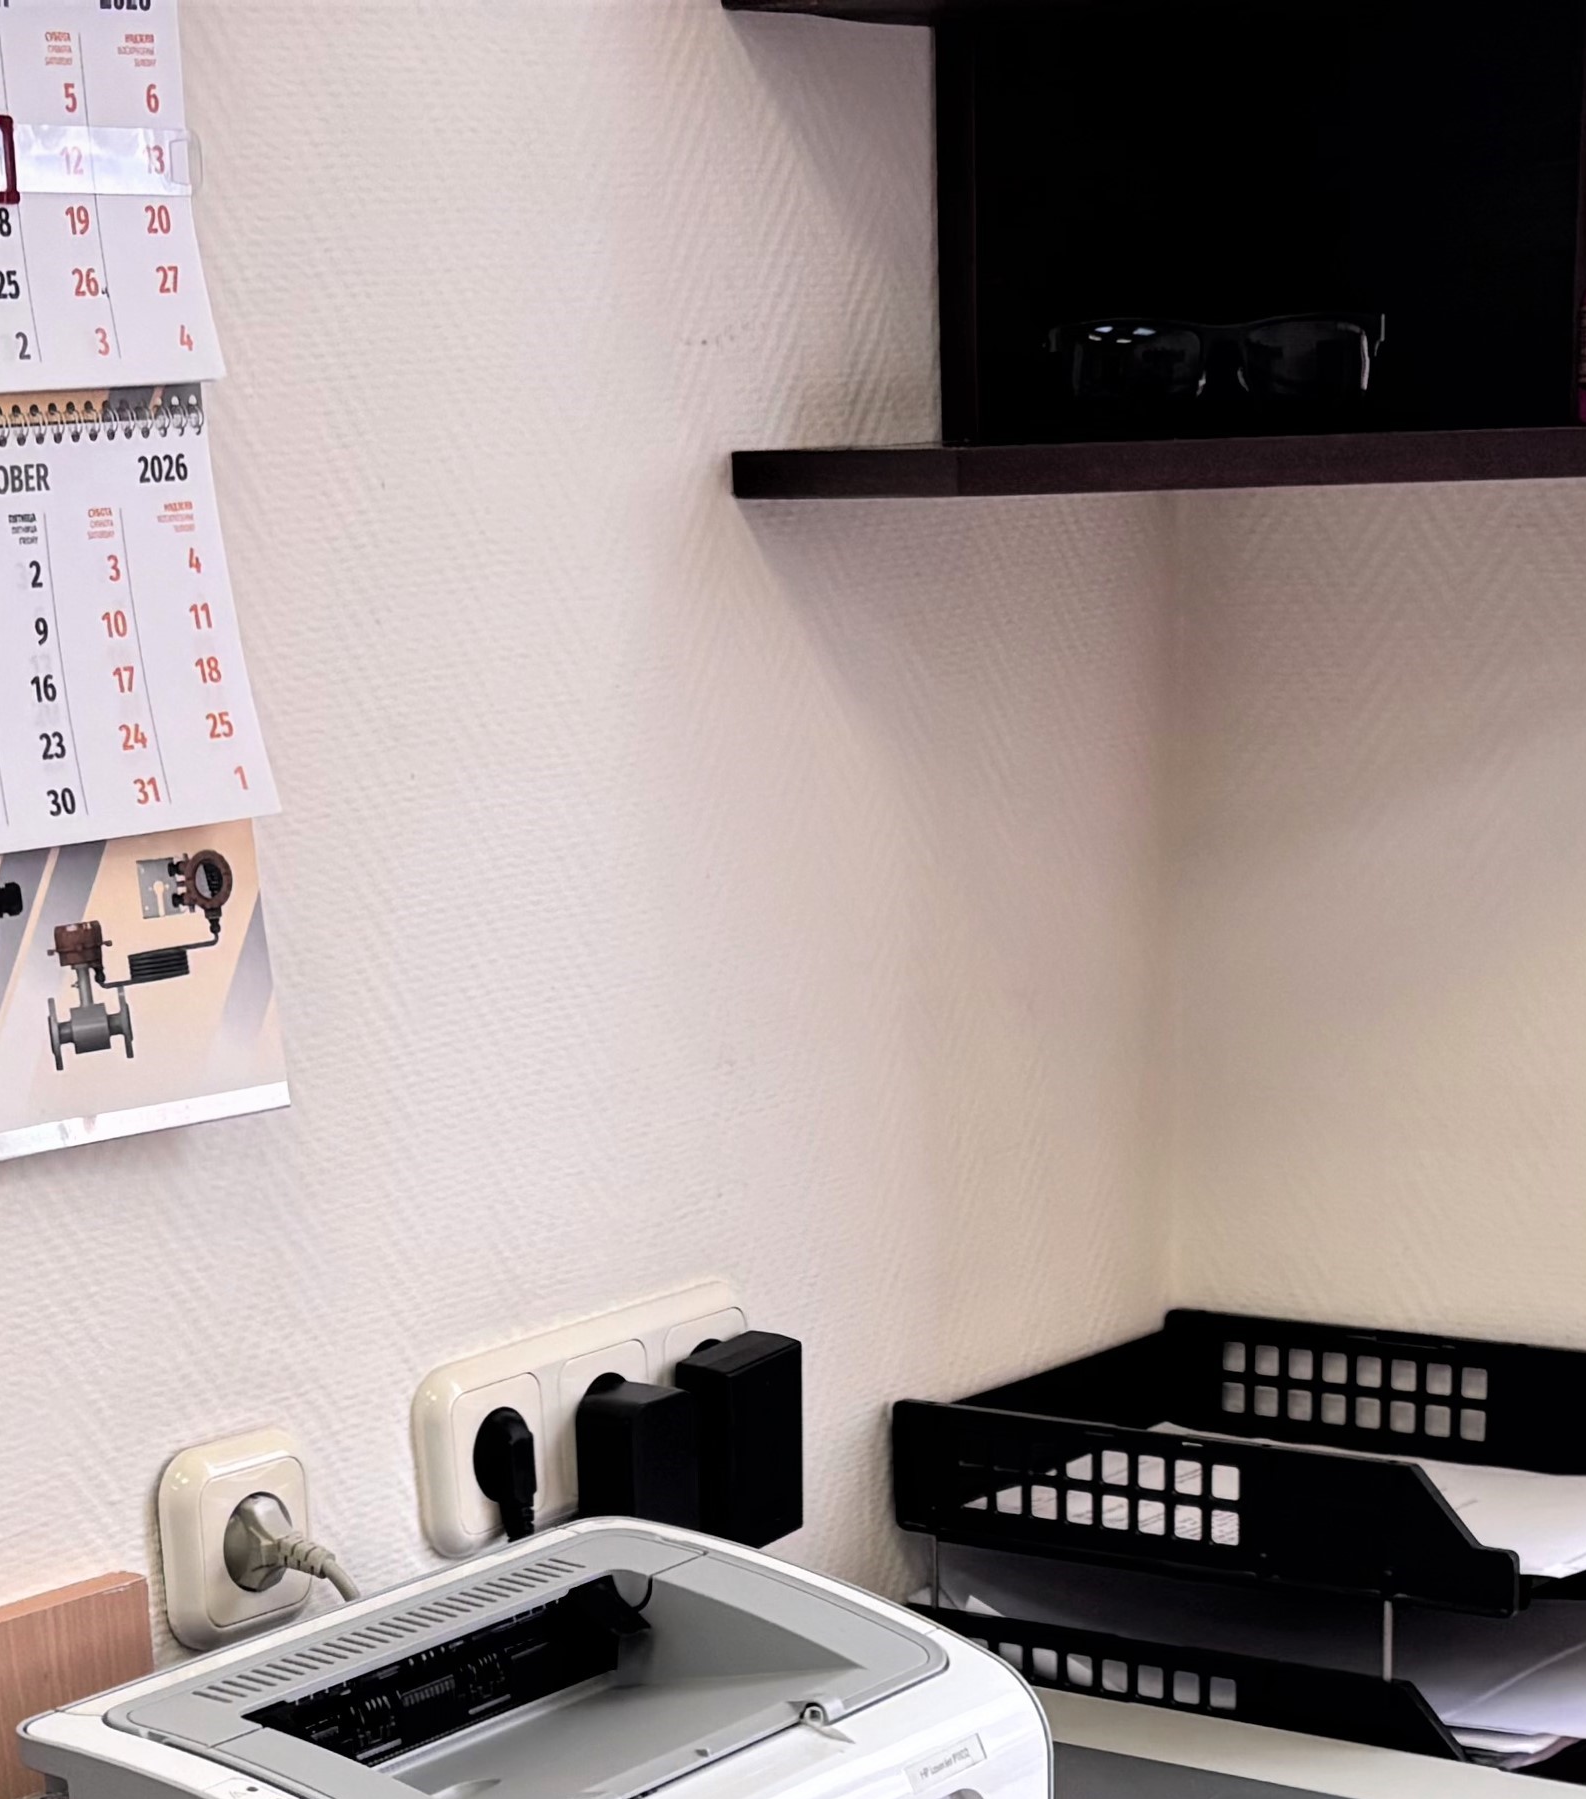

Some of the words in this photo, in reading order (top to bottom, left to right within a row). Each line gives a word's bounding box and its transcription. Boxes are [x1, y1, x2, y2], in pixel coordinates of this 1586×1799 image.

[63, 82, 78, 113] 5
[145, 83, 160, 114] 6
[65, 205, 90, 235] 19
[145, 206, 171, 234] 20
[72, 268, 100, 297] 26
[156, 266, 179, 294] 27
[15, 332, 31, 361] 2
[95, 327, 110, 356] 3
[180, 325, 193, 352] 4
[137, 452, 189, 484] 2026
[29, 560, 44, 589] 2
[107, 554, 121, 582] 3
[188, 547, 202, 574] 4
[35, 617, 48, 645] 9
[102, 610, 127, 638] 10
[189, 602, 213, 630] 11
[31, 674, 57, 703] 16
[113, 666, 135, 693] 17
[195, 656, 222, 684] 18
[39, 731, 66, 760] 23
[118, 723, 147, 751] 24
[206, 711, 233, 739] 25
[46, 787, 76, 816] 30
[133, 777, 161, 805] 31
[234, 766, 249, 790] 1
